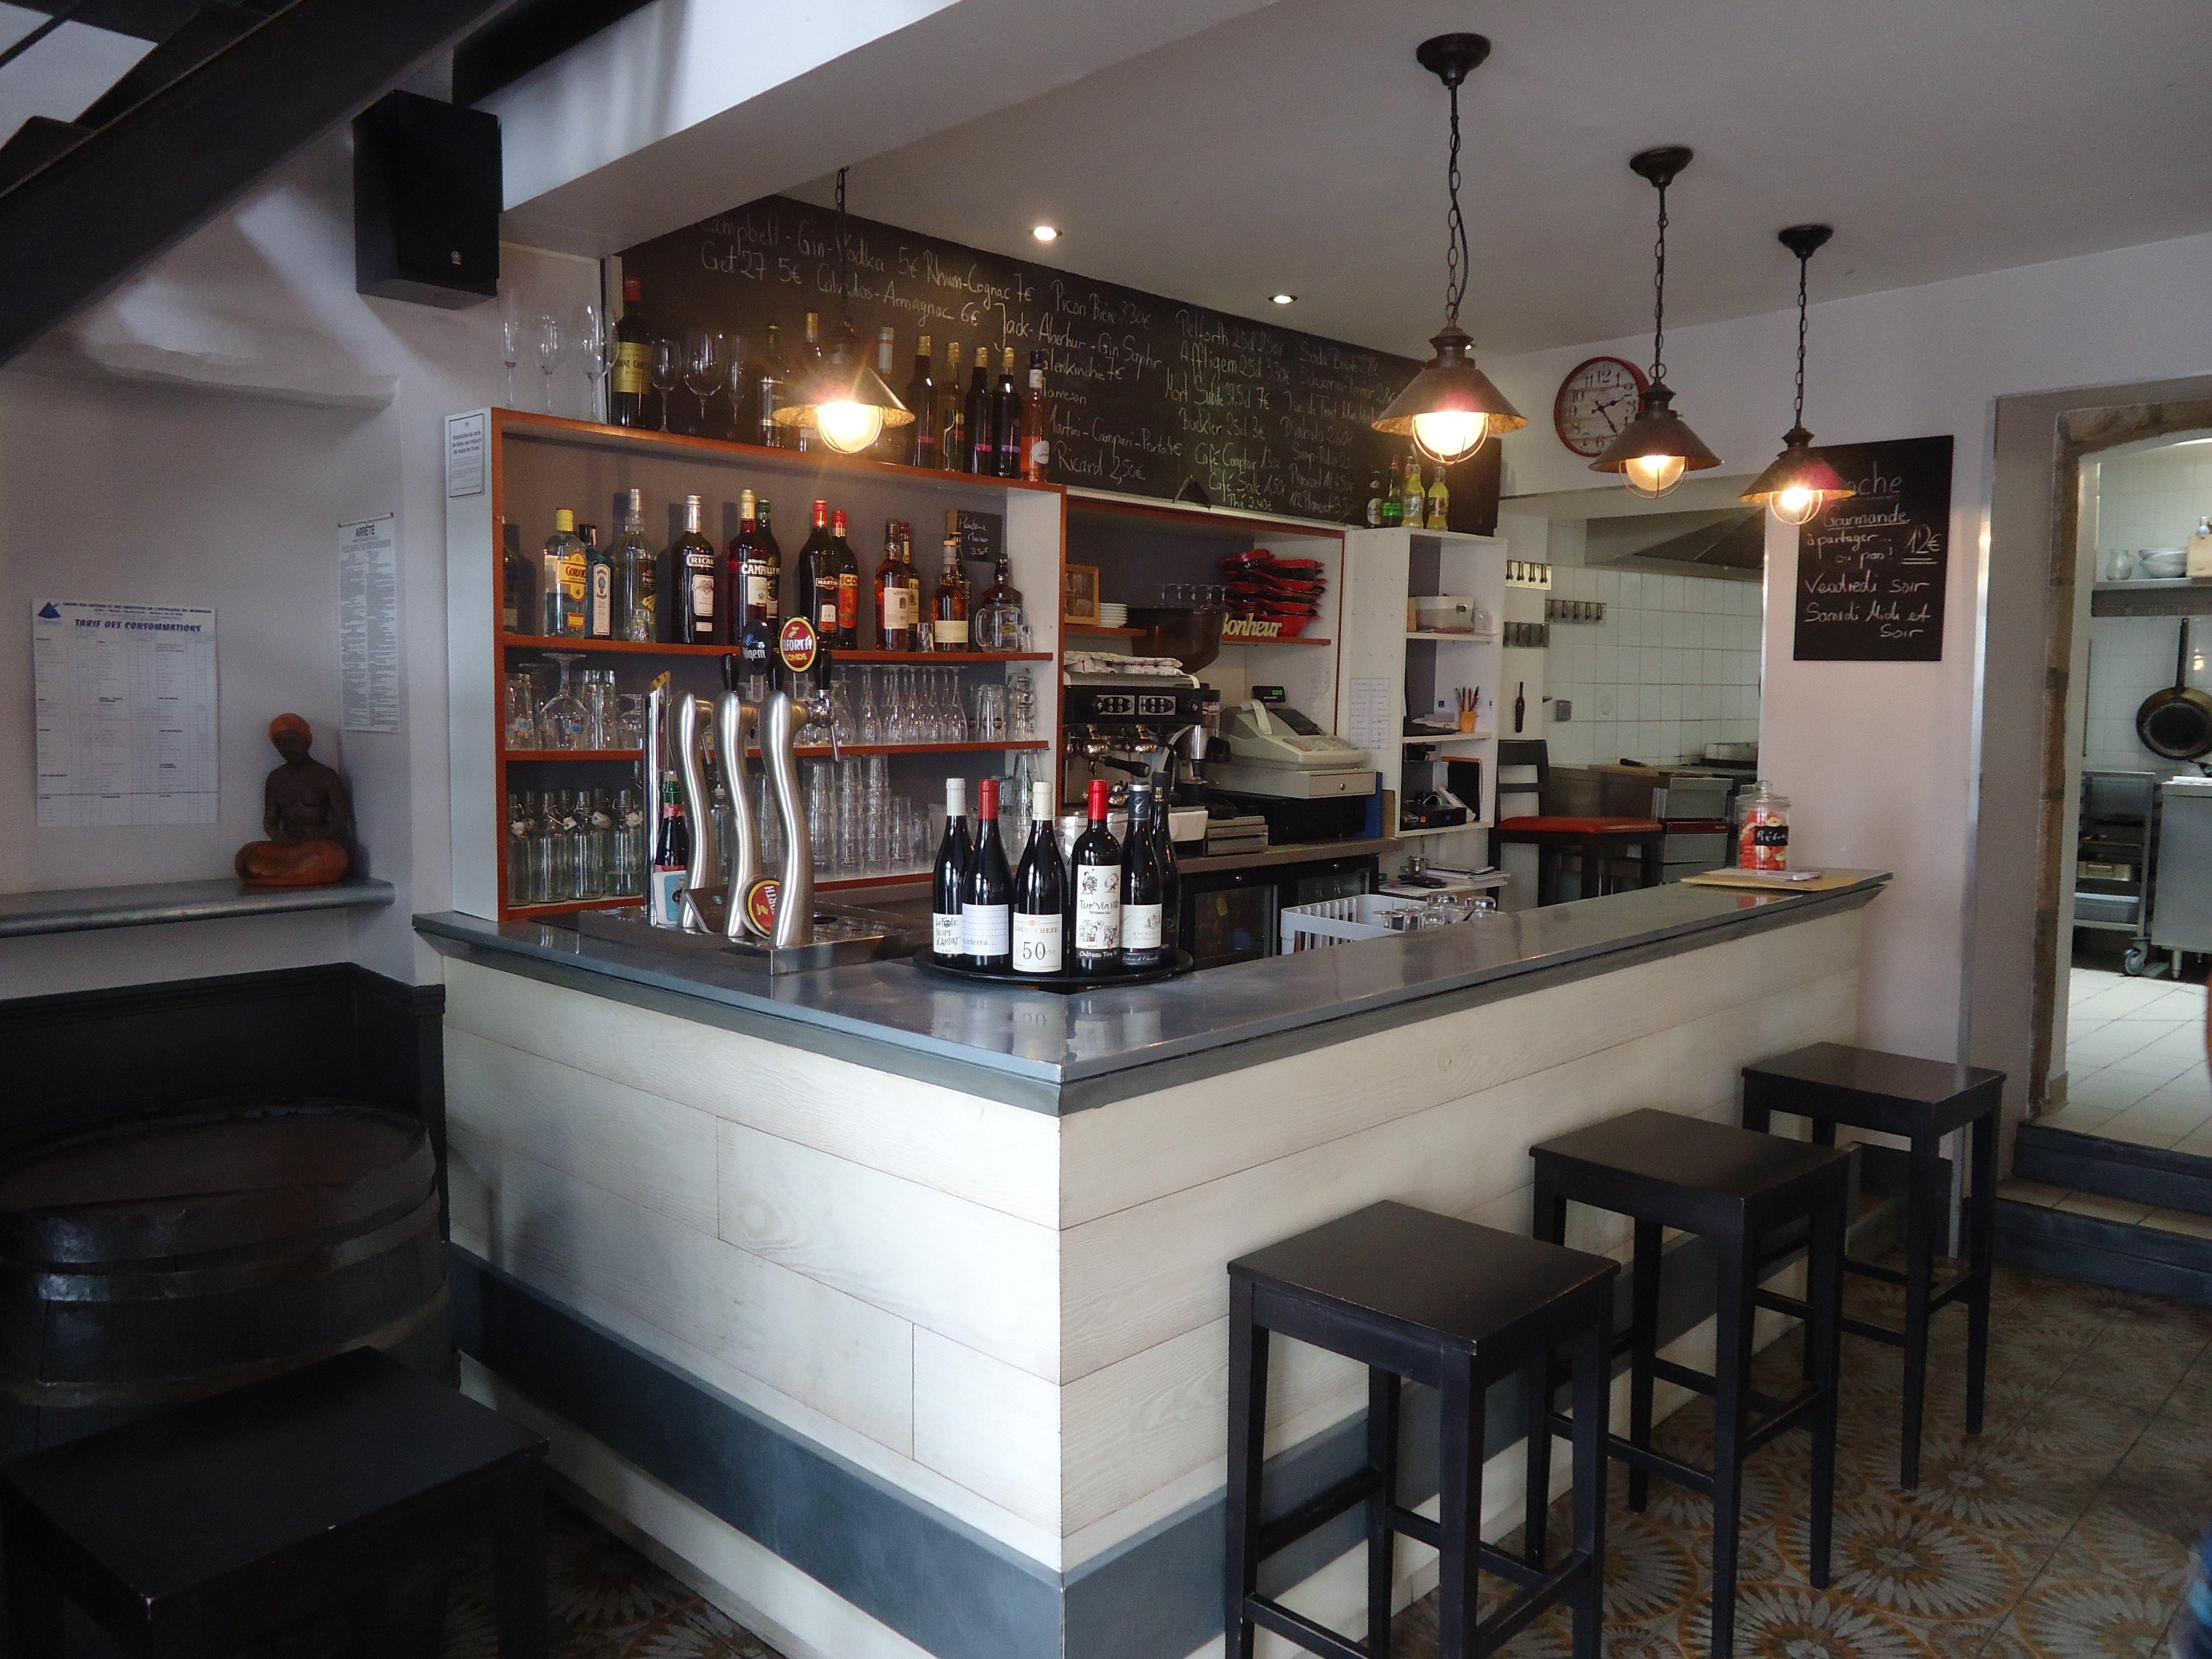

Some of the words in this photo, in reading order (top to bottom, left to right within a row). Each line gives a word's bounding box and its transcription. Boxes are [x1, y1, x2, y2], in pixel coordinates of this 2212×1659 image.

[700, 213, 779, 257] Campbell
[701, 240, 738, 274] Get
[740, 250, 767, 281] 27
[778, 257, 802, 285] 5€
[961, 302, 981, 326] 6€
[1051, 279, 1087, 317] Picon
[1180, 339, 1238, 383] Affligem
[1179, 407, 1223, 435] Buckler
[1054, 440, 1103, 477] Ricard
[1195, 441, 1221, 473] Café
[1208, 469, 1235, 503] Café
[1907, 525, 1942, 555] 12€
[1805, 569, 1879, 594] Vendredi
[75, 619, 101, 628] TARIF
[104, 620, 121, 629] DES
[124, 622, 202, 632] CONSOMMATIONS
[1804, 602, 1860, 623] Samedi
[1865, 599, 1900, 623] Midi
[1904, 603, 1931, 623] et
[1023, 941, 1046, 961] 50
